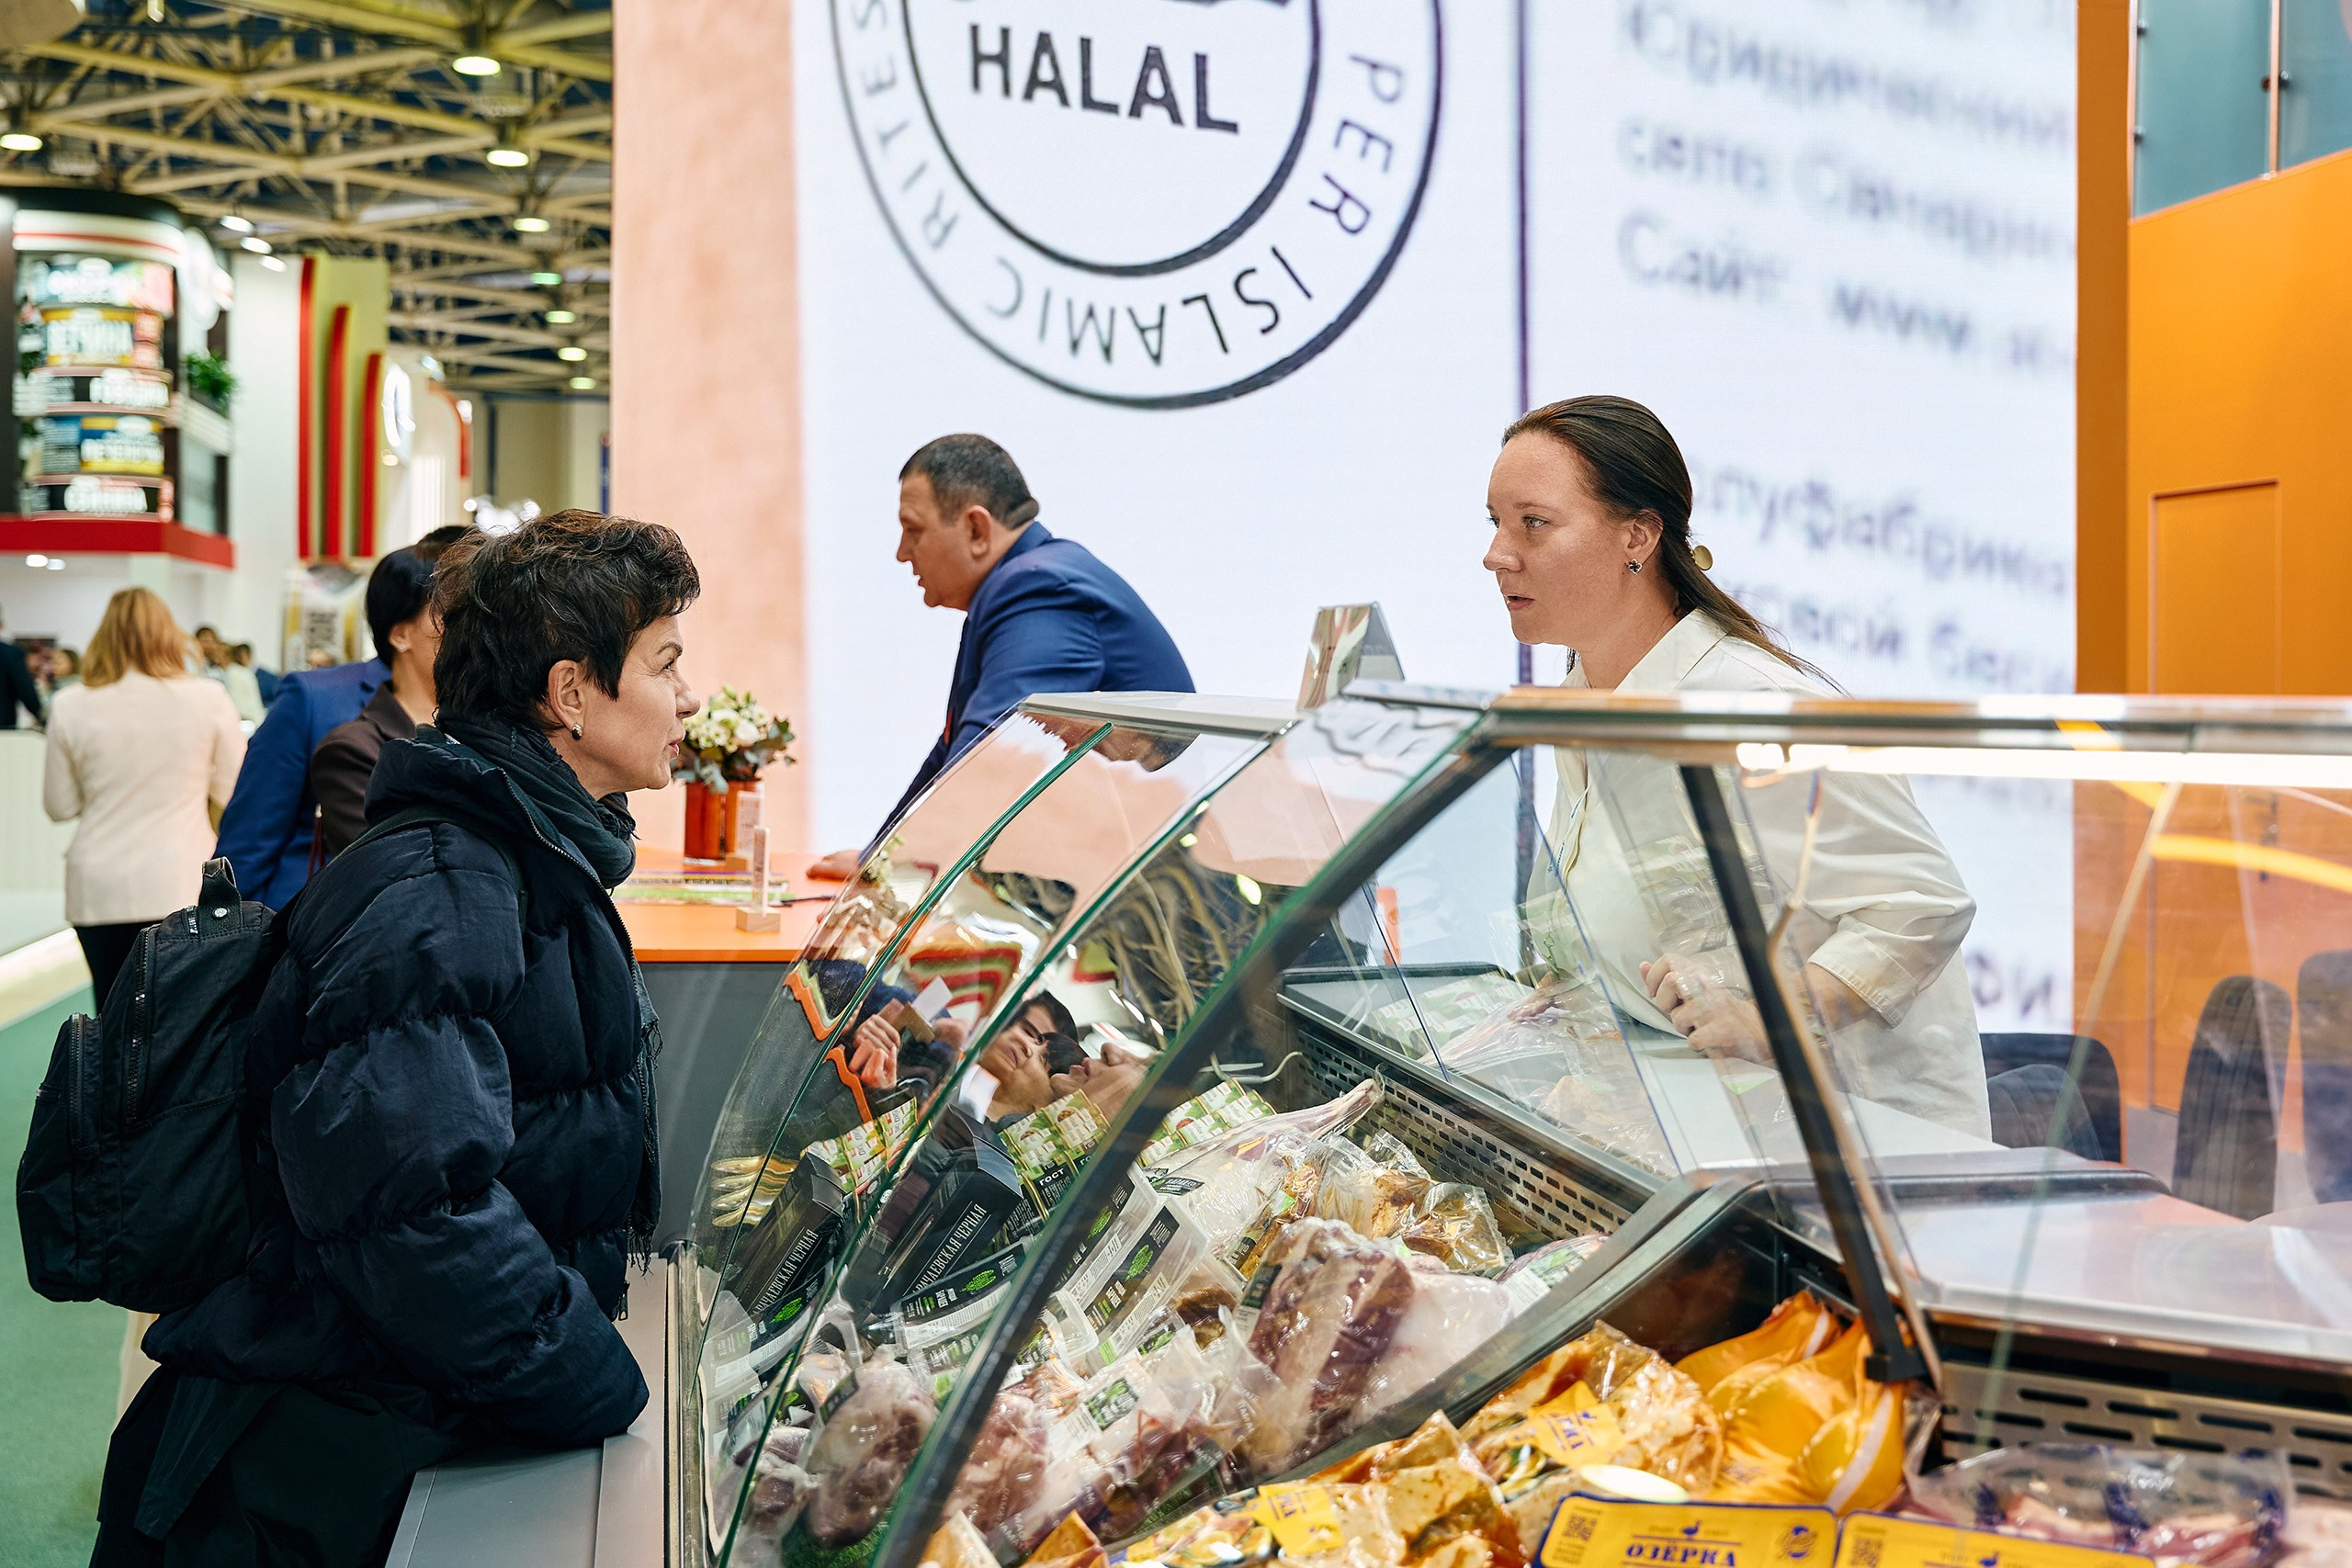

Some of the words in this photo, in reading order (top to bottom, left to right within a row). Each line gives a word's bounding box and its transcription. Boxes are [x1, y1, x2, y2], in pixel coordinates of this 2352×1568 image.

[852, 0, 959, 252] RITES
[969, 23, 1238, 135] HALAL
[1308, 52, 1405, 235] PER
[983, 245, 1312, 367] ISLAMIC
[1039, 1168, 1065, 1186] ГОСТ
[752, 1259, 797, 1314] РАЧАЕВСКАЯ
[789, 1228, 819, 1262] ЧЕРНАЯ
[911, 1236, 962, 1293] РАЧАЕВСКАЯ
[954, 1203, 988, 1241] ЧЕРНАЯ
